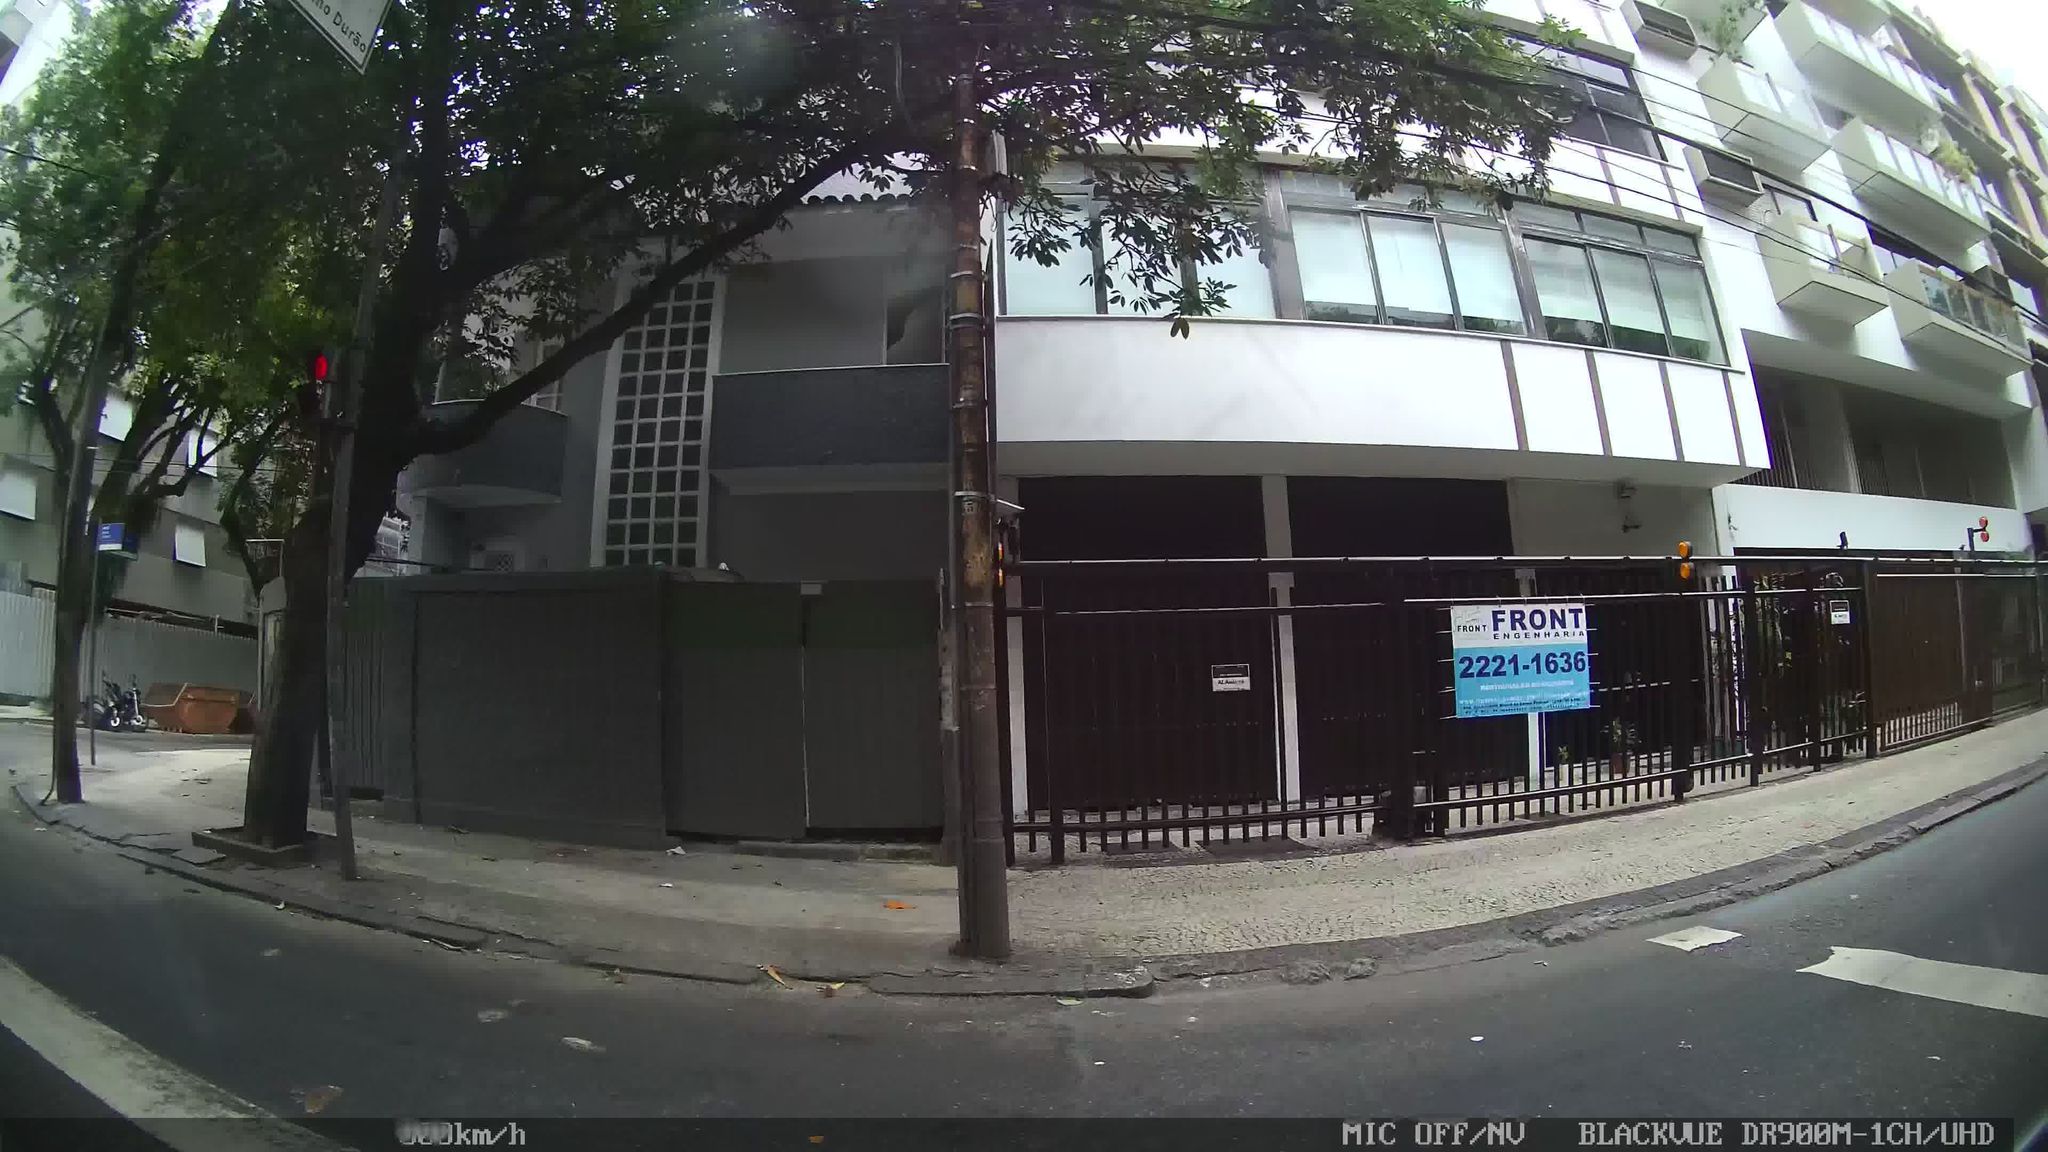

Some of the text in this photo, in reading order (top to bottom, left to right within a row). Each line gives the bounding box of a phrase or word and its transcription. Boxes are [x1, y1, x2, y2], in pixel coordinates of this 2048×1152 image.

[332, 10, 367, 53] Durão
[1457, 624, 1488, 633] FRONT
[1491, 607, 1584, 632] FRONT
[1493, 630, 1585, 640] ENGENHARIA
[1458, 650, 1587, 679] 2221-1636
